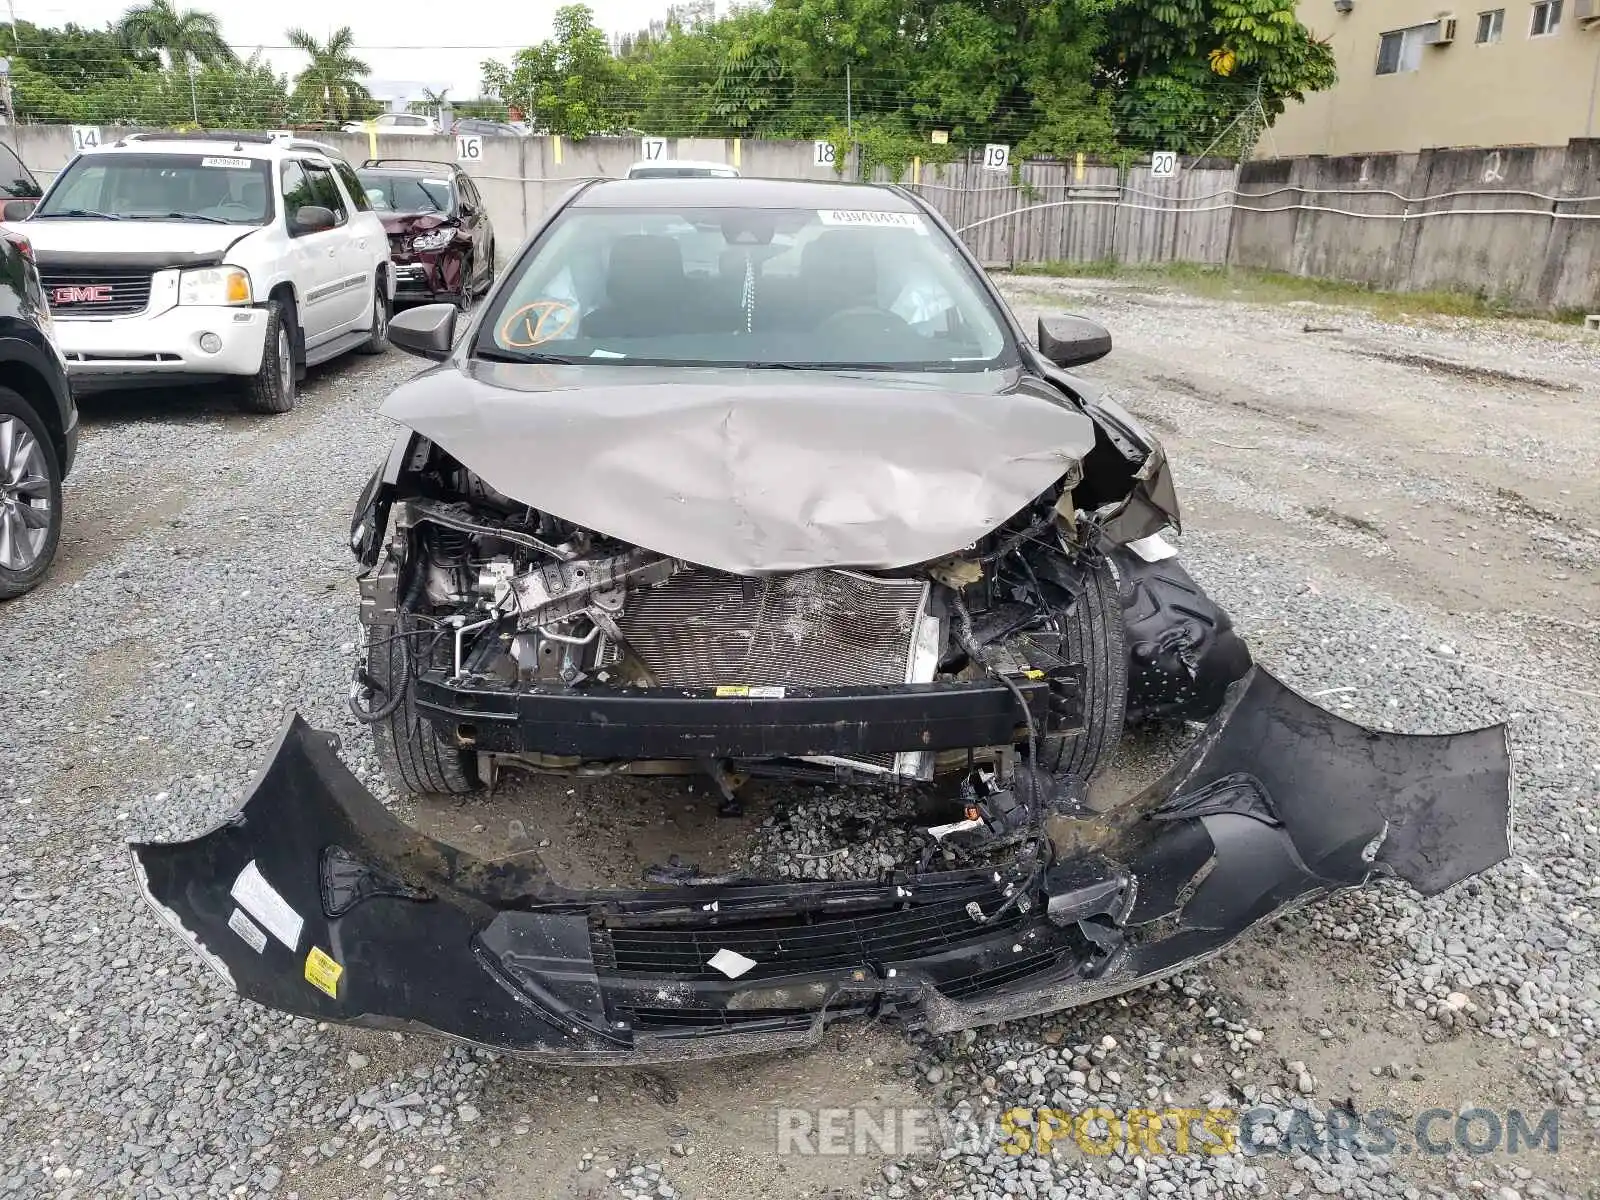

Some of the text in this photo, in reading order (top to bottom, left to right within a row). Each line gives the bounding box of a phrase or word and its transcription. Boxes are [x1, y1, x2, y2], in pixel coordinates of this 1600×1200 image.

[76, 129, 98, 149] 14
[460, 139, 479, 158] 16
[644, 141, 664, 160] 17
[817, 144, 836, 162] 18
[987, 148, 1005, 166] 19
[1154, 155, 1173, 173] 20
[54, 285, 113, 303] GMC
